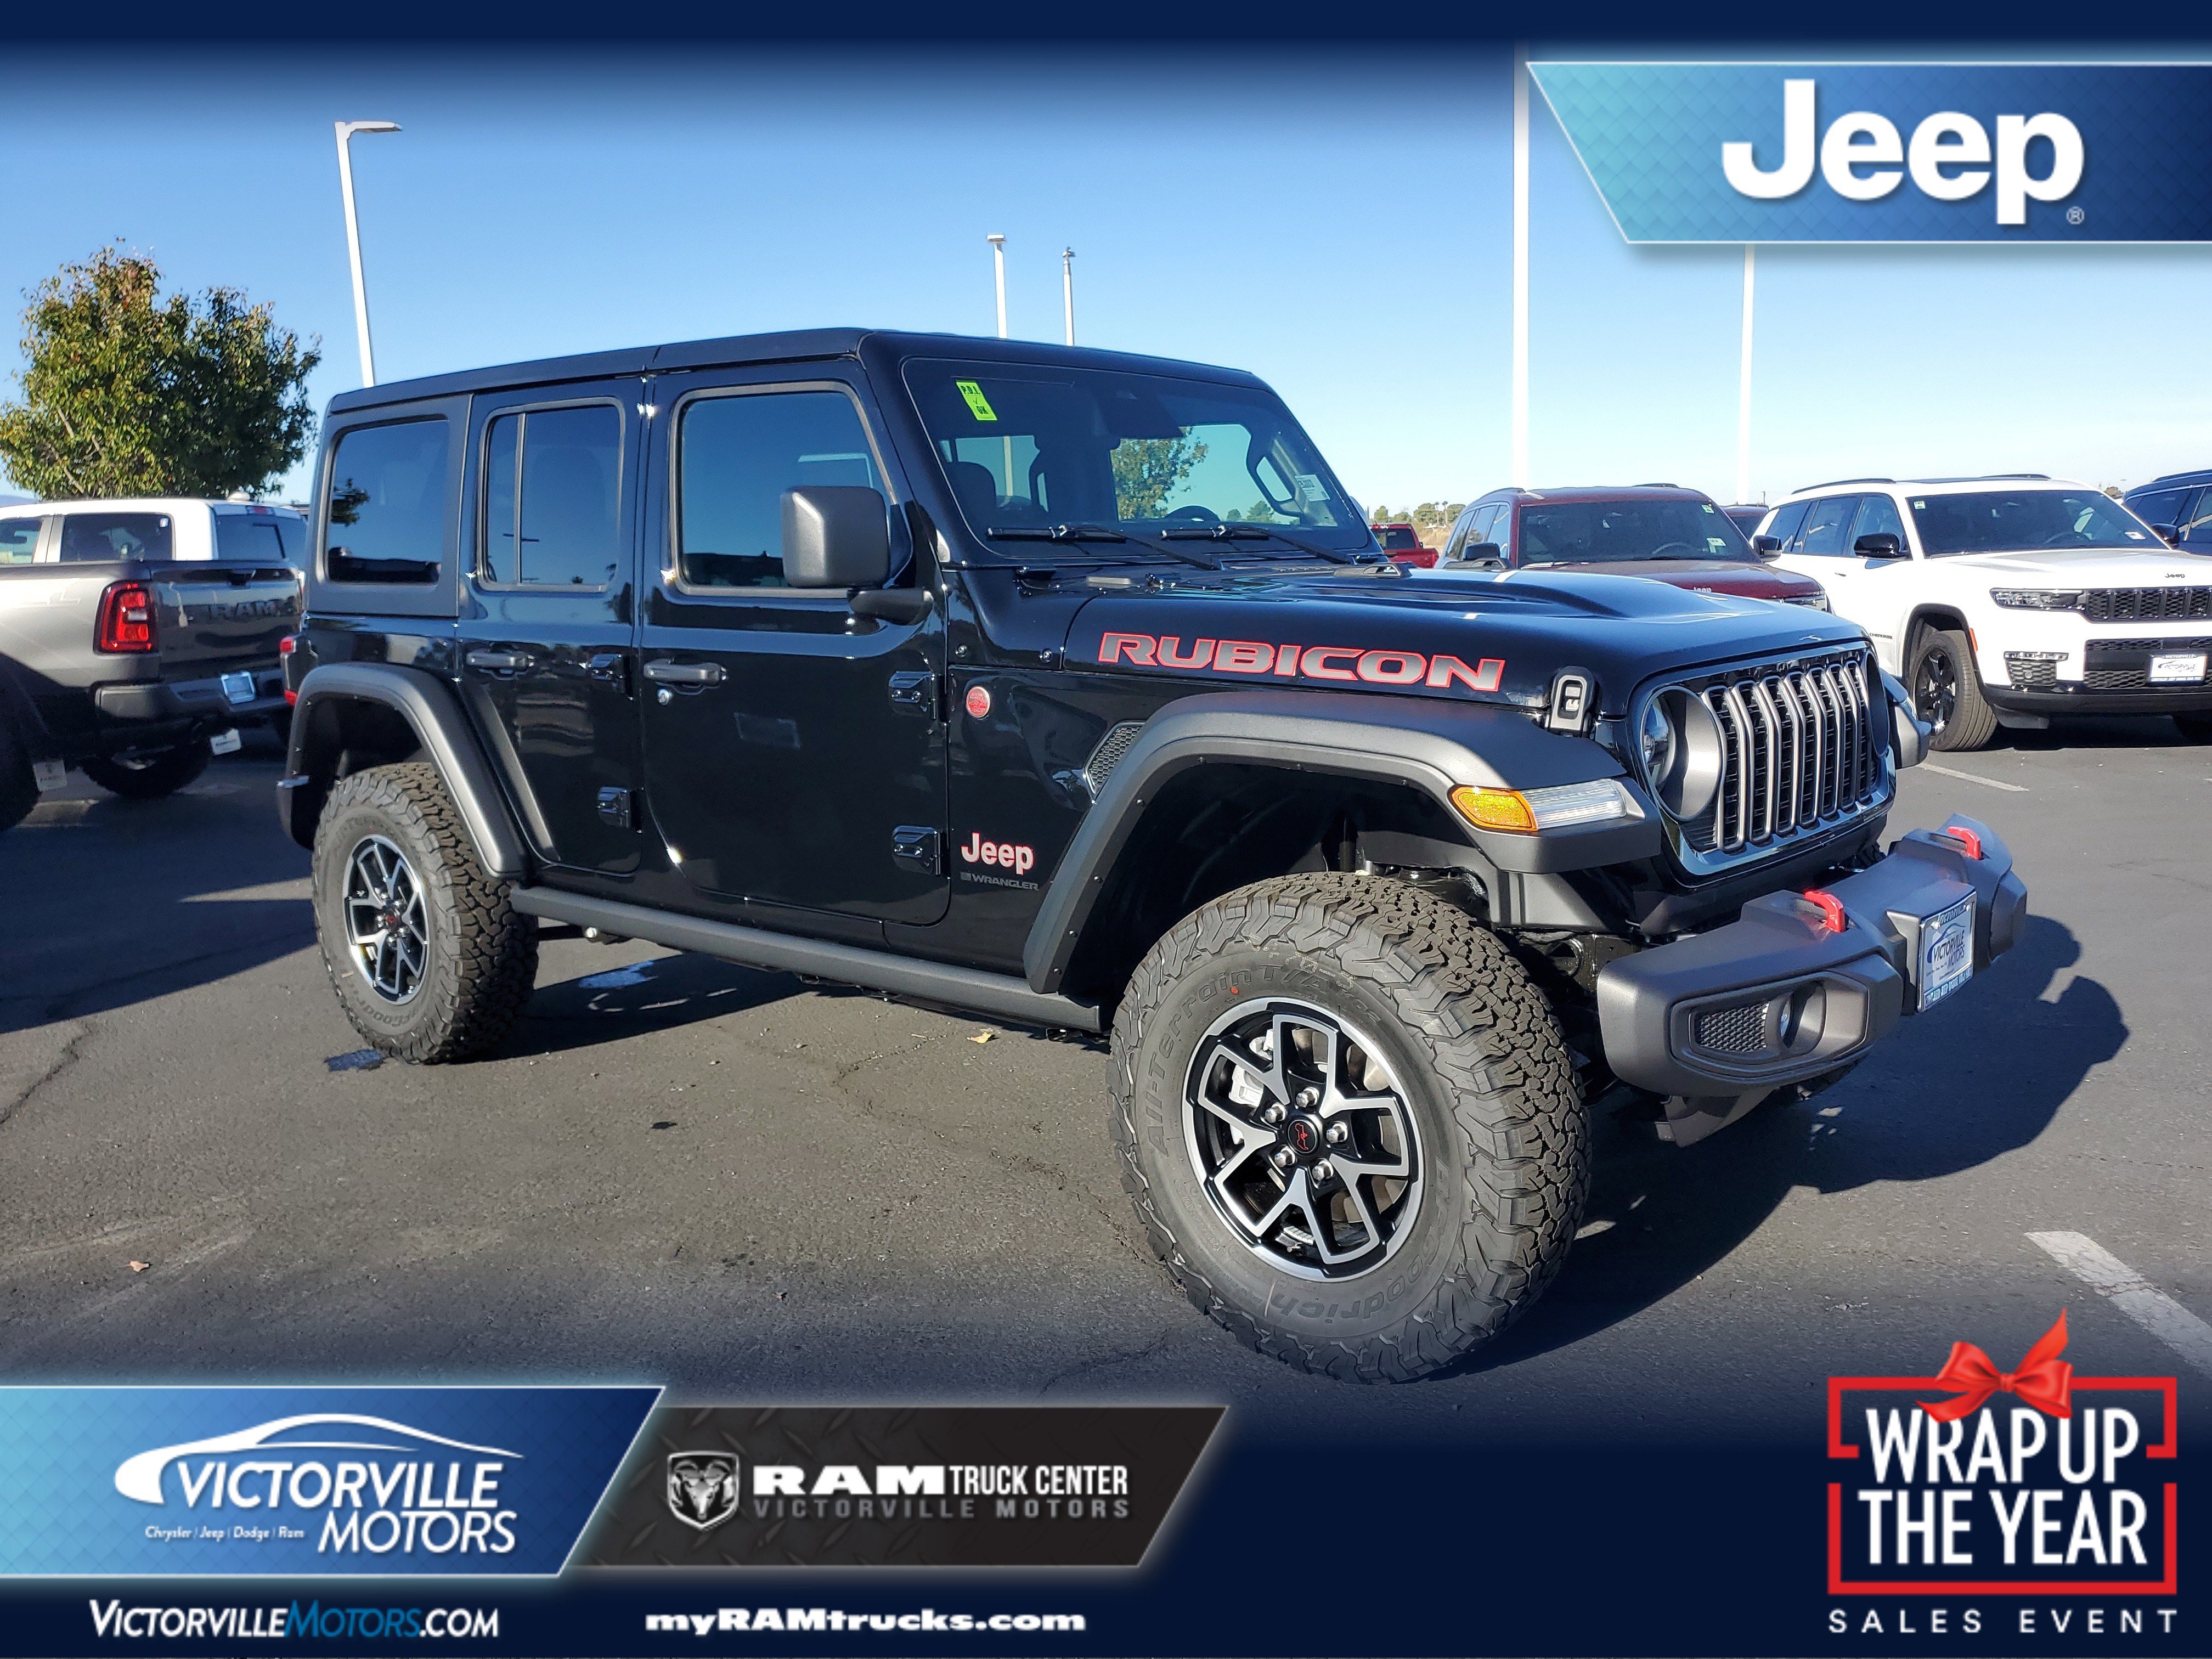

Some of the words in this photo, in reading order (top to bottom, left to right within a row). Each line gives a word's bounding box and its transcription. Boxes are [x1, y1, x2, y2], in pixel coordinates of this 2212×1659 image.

[975, 405, 989, 415] OK
[1097, 631, 1506, 692] RUBICON
[961, 832, 1034, 876] Jeep
[972, 873, 1039, 891] WRANGLER
[1933, 929, 1965, 963] VICTORVILLE
[1145, 968, 1252, 1158] All-Terrain
